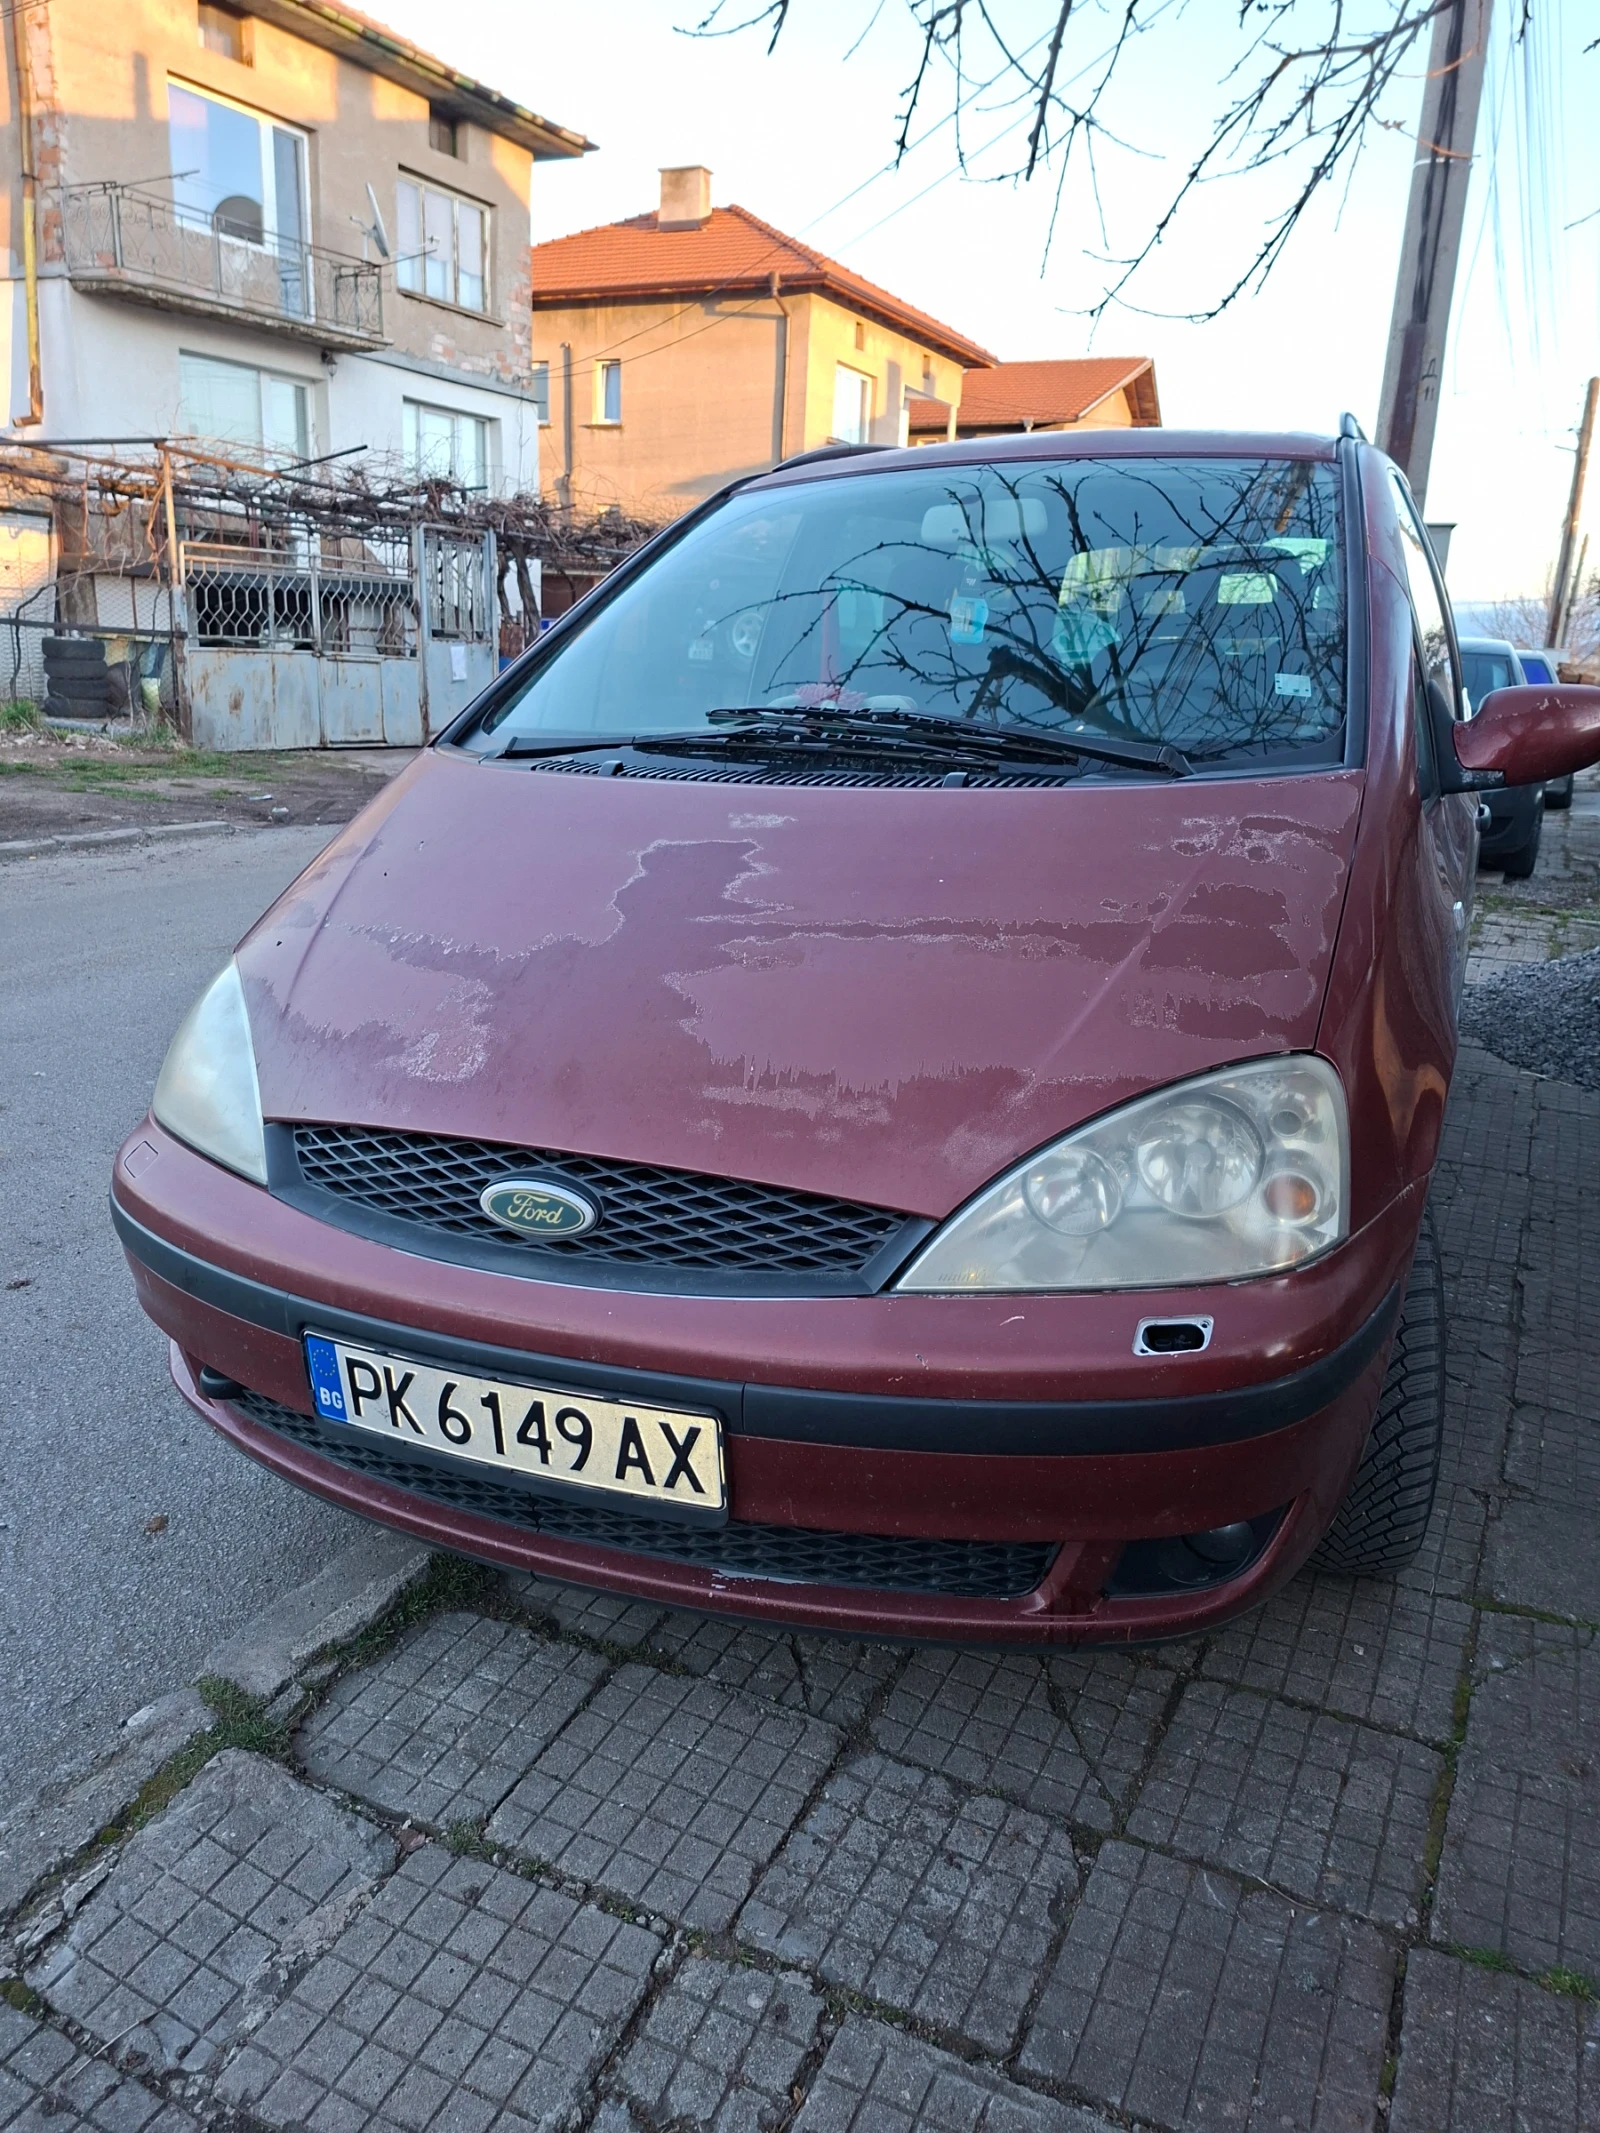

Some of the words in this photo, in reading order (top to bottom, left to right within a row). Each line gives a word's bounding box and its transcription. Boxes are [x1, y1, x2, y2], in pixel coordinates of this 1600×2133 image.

[507, 1193, 564, 1224] Ford
[319, 1387, 343, 1409] BG
[345, 1356, 427, 1436] PK
[438, 1380, 593, 1472] 6149
[615, 1416, 706, 1494] AX
